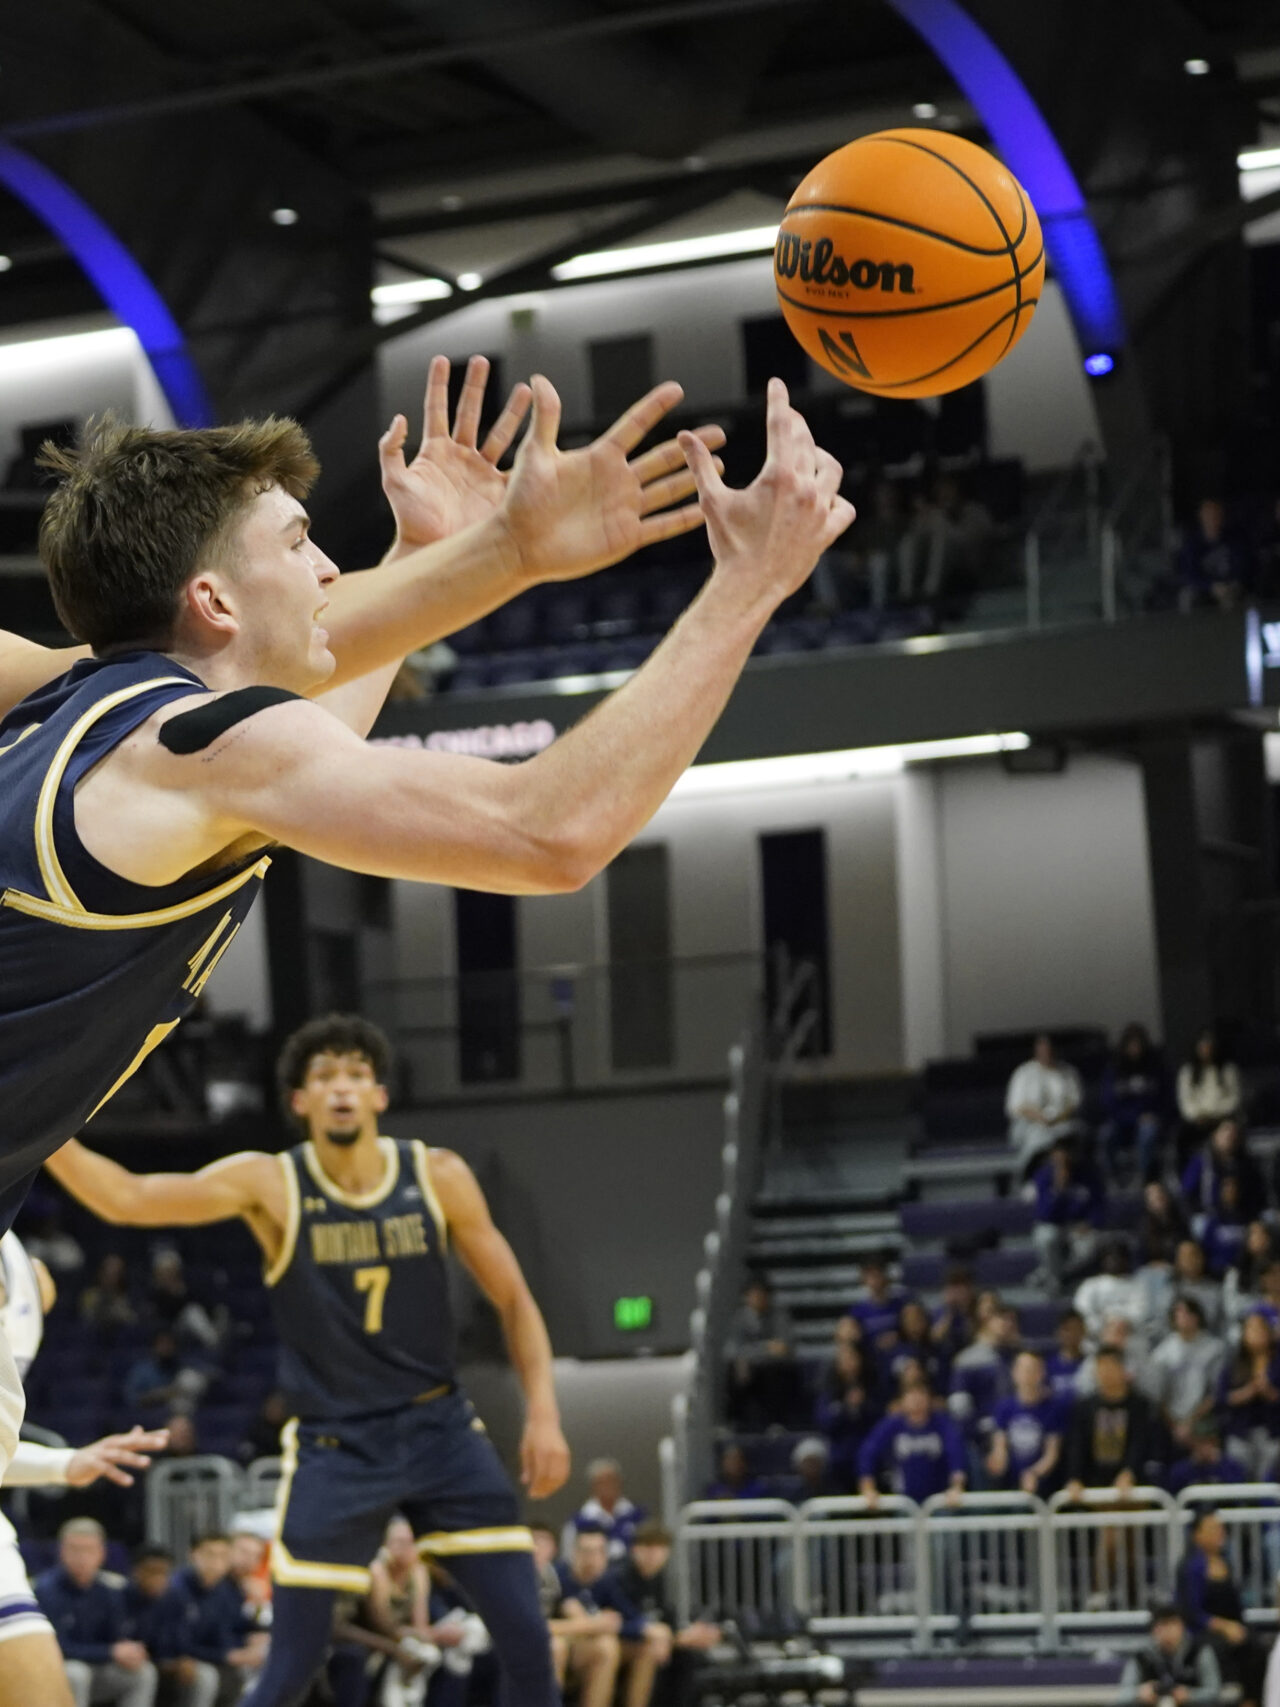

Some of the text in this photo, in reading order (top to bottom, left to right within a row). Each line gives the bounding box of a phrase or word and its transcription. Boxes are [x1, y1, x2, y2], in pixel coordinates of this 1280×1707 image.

[776, 231, 915, 294] Wilson
[817, 328, 873, 379] N
[353, 1265, 391, 1335] 7
